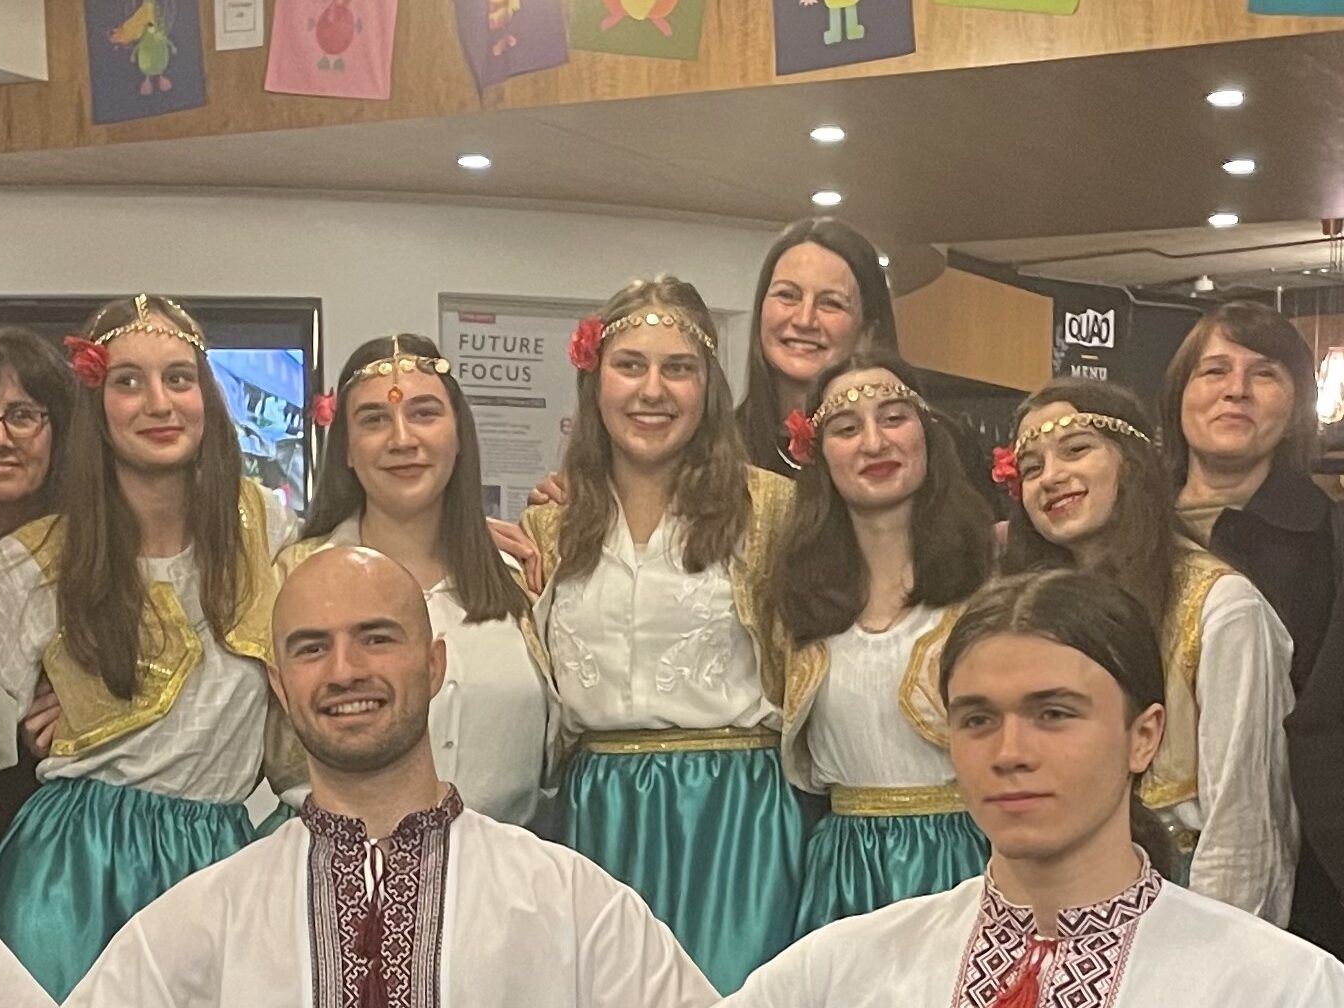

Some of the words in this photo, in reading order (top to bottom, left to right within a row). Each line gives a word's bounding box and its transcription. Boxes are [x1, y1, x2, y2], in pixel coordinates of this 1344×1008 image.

[458, 333, 545, 355] FUTURE
[458, 363, 532, 383] FOCUS
[1070, 364, 1108, 381] MENU
